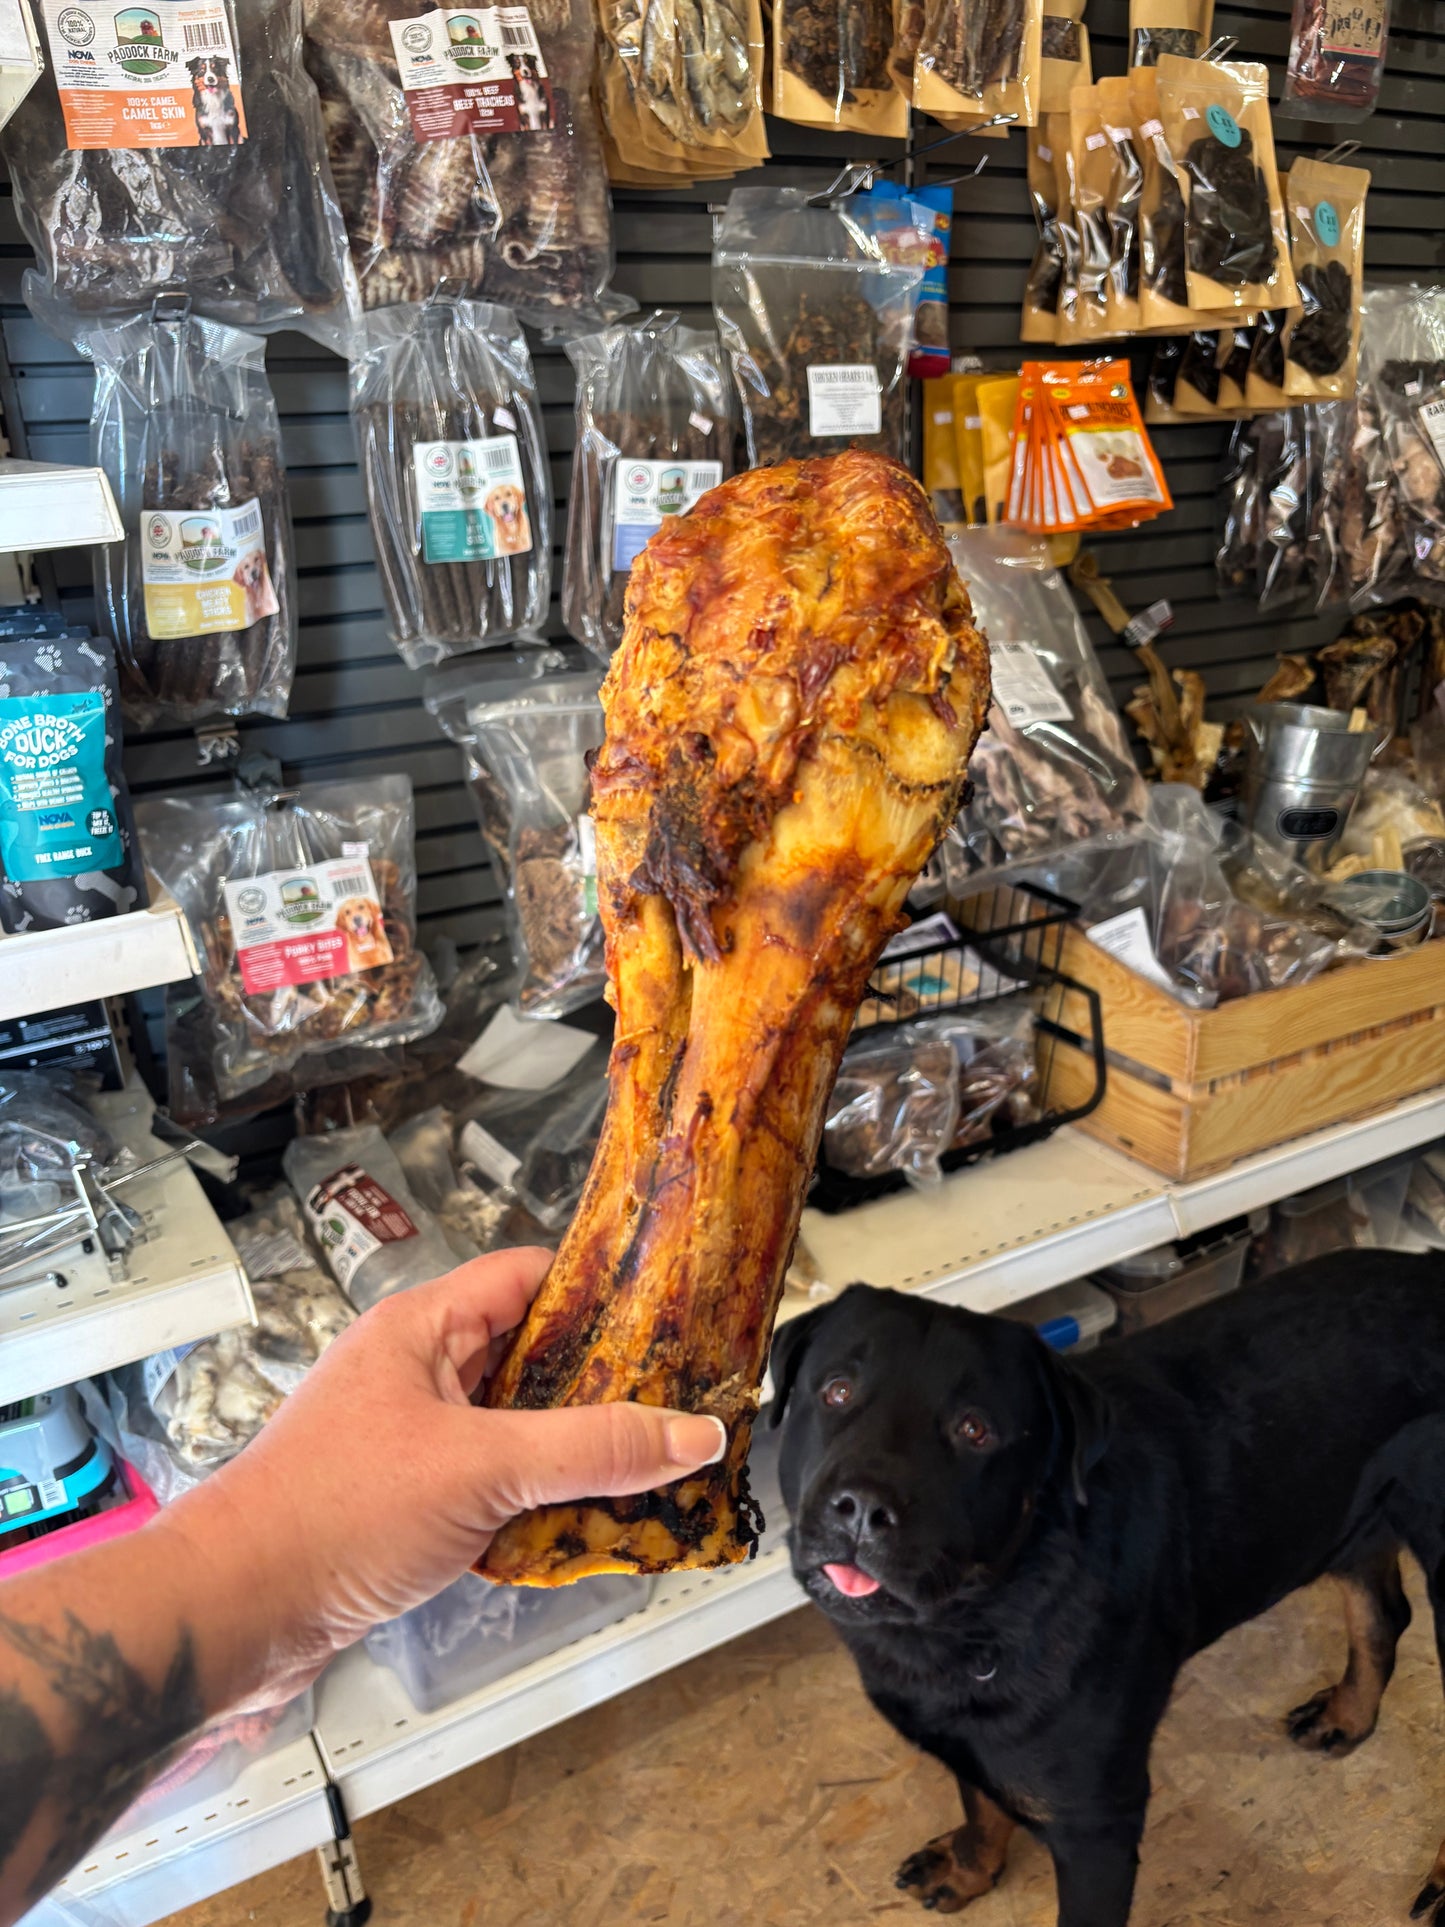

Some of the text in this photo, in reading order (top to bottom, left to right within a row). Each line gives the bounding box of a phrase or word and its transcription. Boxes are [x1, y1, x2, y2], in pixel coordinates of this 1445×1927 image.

[68, 49, 95, 61] NOVA
[107, 45, 150, 63] PADDOCK
[153, 47, 179, 63] FARM
[443, 46, 475, 60] PADDOCK
[126, 96, 178, 107] 100% CAMEL
[121, 106, 186, 120] CAMEL SKIN
[33, 713, 87, 743] BROTH
[14, 726, 68, 756] DUCK
[4, 744, 79, 769] FOR DOGS
[38, 811, 74, 826] NOVA
[52, 849, 76, 862] RANGE
[75, 846, 93, 858] DUCK
